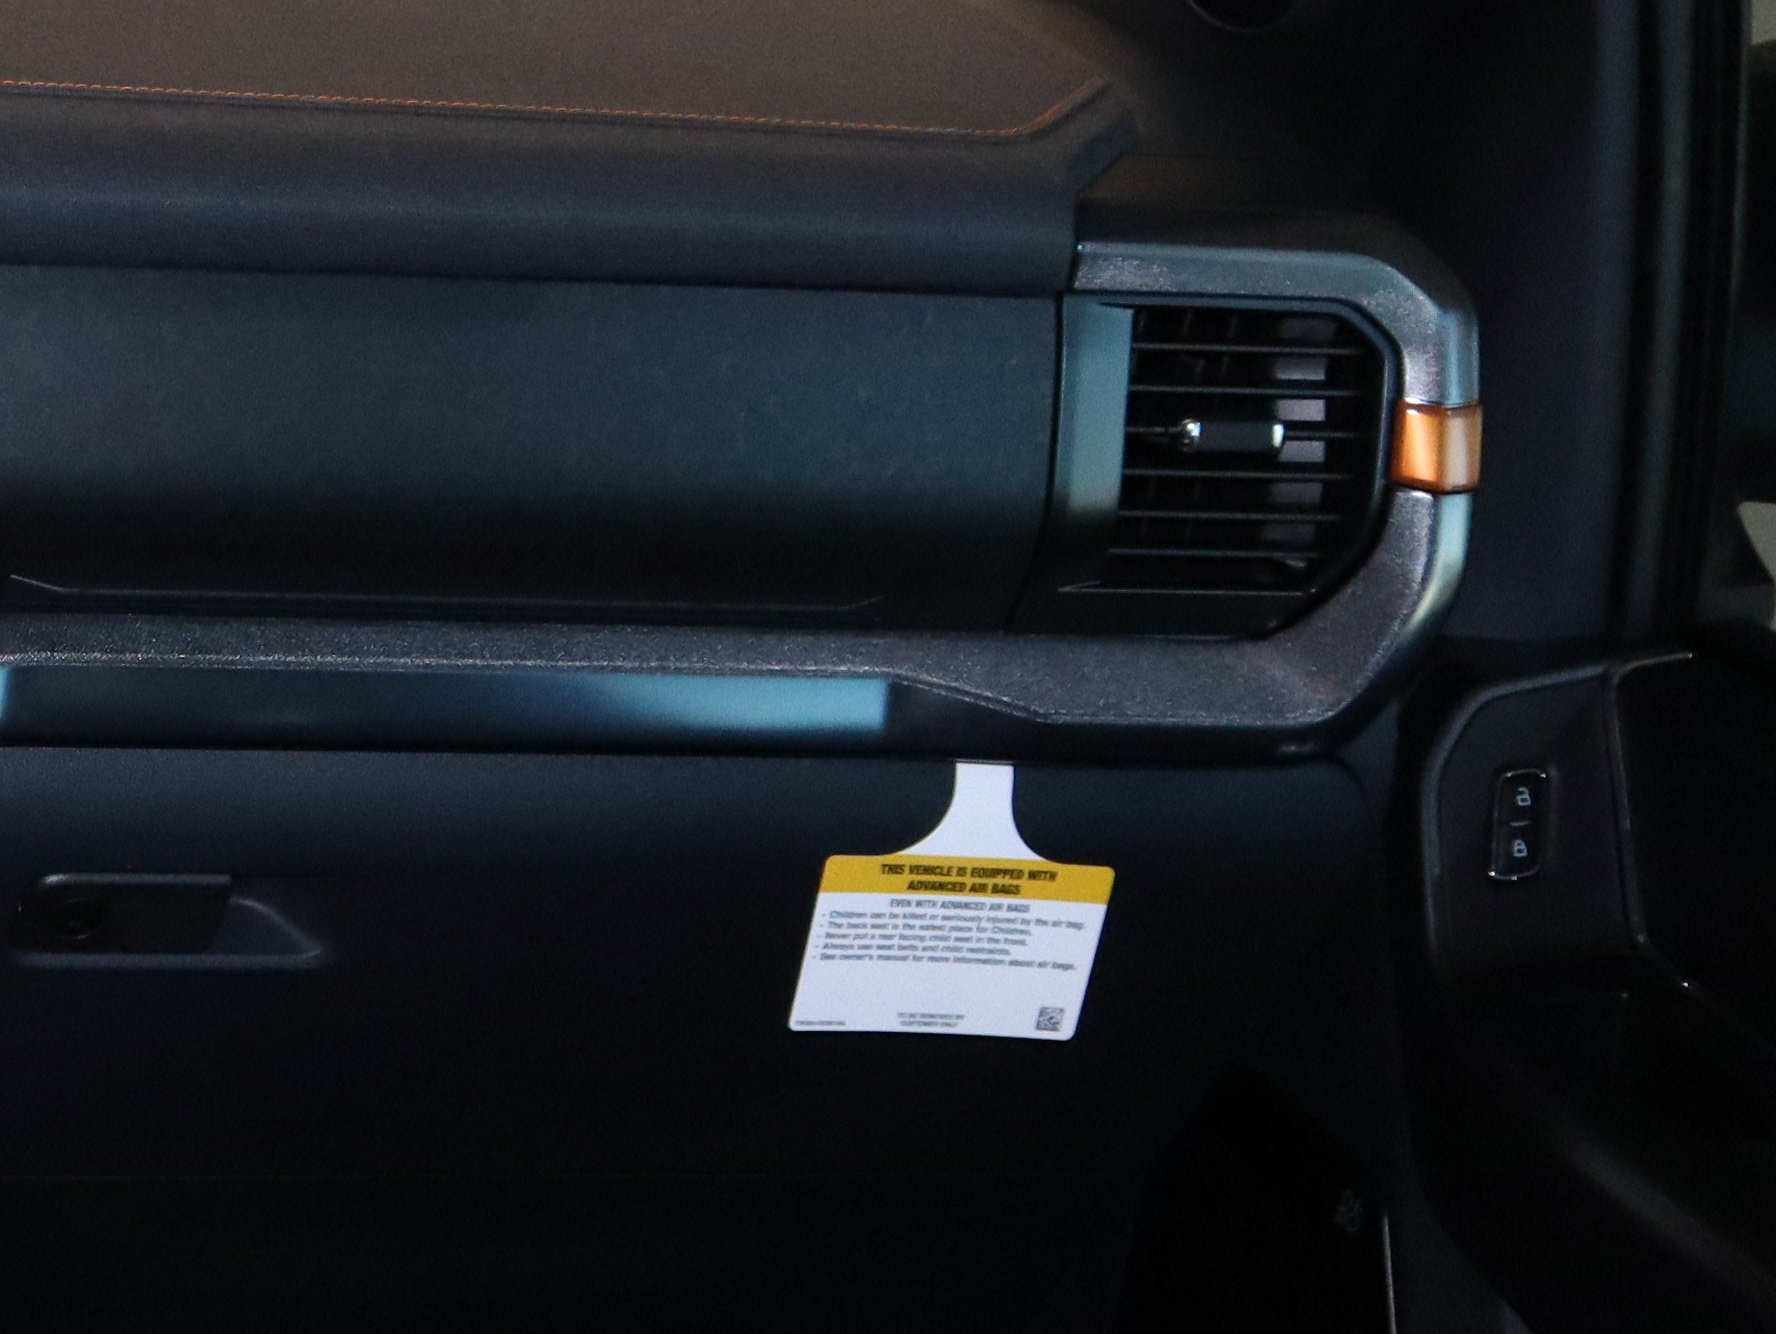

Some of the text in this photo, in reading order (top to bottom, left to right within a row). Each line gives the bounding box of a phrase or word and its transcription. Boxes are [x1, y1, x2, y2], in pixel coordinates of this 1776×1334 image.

[881, 863, 1058, 882] THIS VEHICLE IS EQUIPPED WITH
[907, 880, 1022, 895] ADVANCED AIR BAGS
[939, 900, 987, 911] ADVANCED
